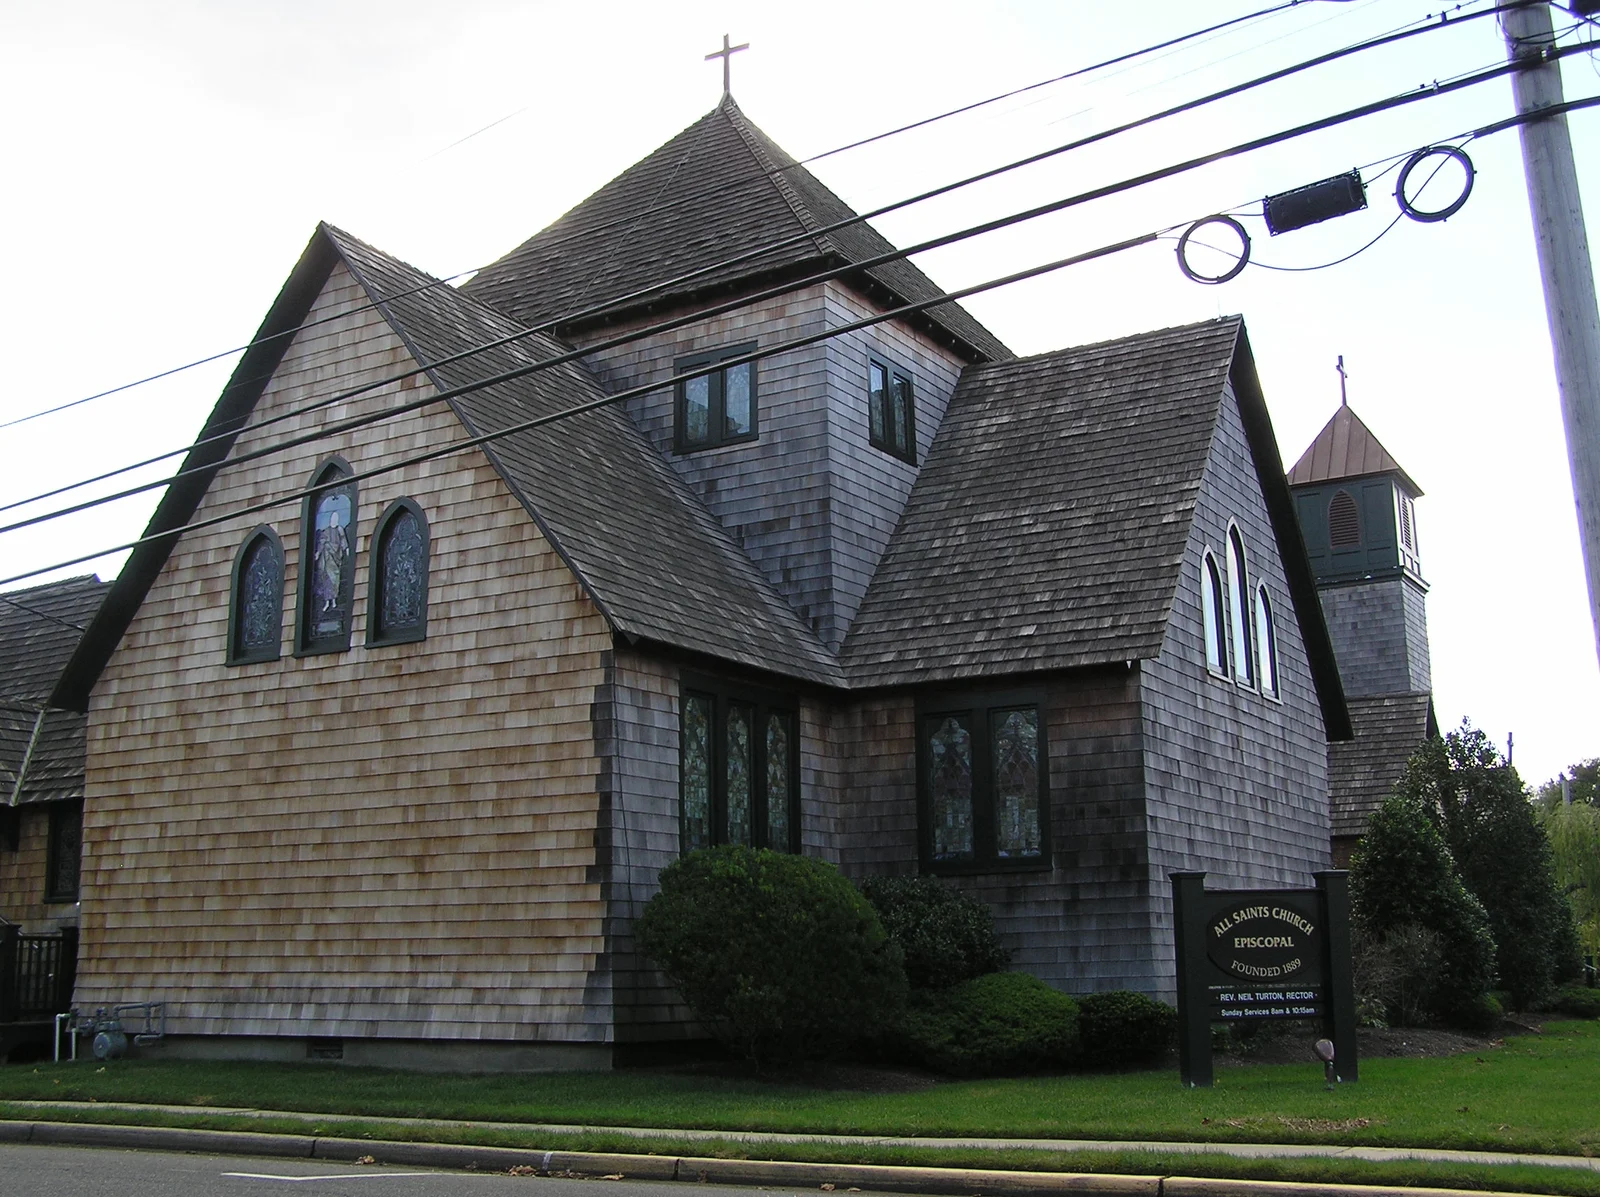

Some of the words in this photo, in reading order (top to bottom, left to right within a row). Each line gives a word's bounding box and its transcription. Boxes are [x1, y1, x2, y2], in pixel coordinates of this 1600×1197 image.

[1214, 918, 1233, 937] ALL
[1232, 906, 1270, 924] SAINTS
[1272, 907, 1315, 936] CHURCH
[1234, 936, 1295, 949] EPISCOPAL
[1231, 960, 1281, 977] FOUNDED
[1282, 958, 1302, 974] 1889
[1220, 993, 1237, 1001] REV.
[1238, 992, 1254, 1001] NEIL
[1255, 992, 1285, 1001] TURTON,
[1286, 991, 1314, 1000] RECTOR
[1221, 1009, 1243, 1017] Sunday
[1244, 1008, 1270, 1016] Services
[1270, 1007, 1284, 1015] 8am
[1292, 1006, 1315, 1014] 10:15am
